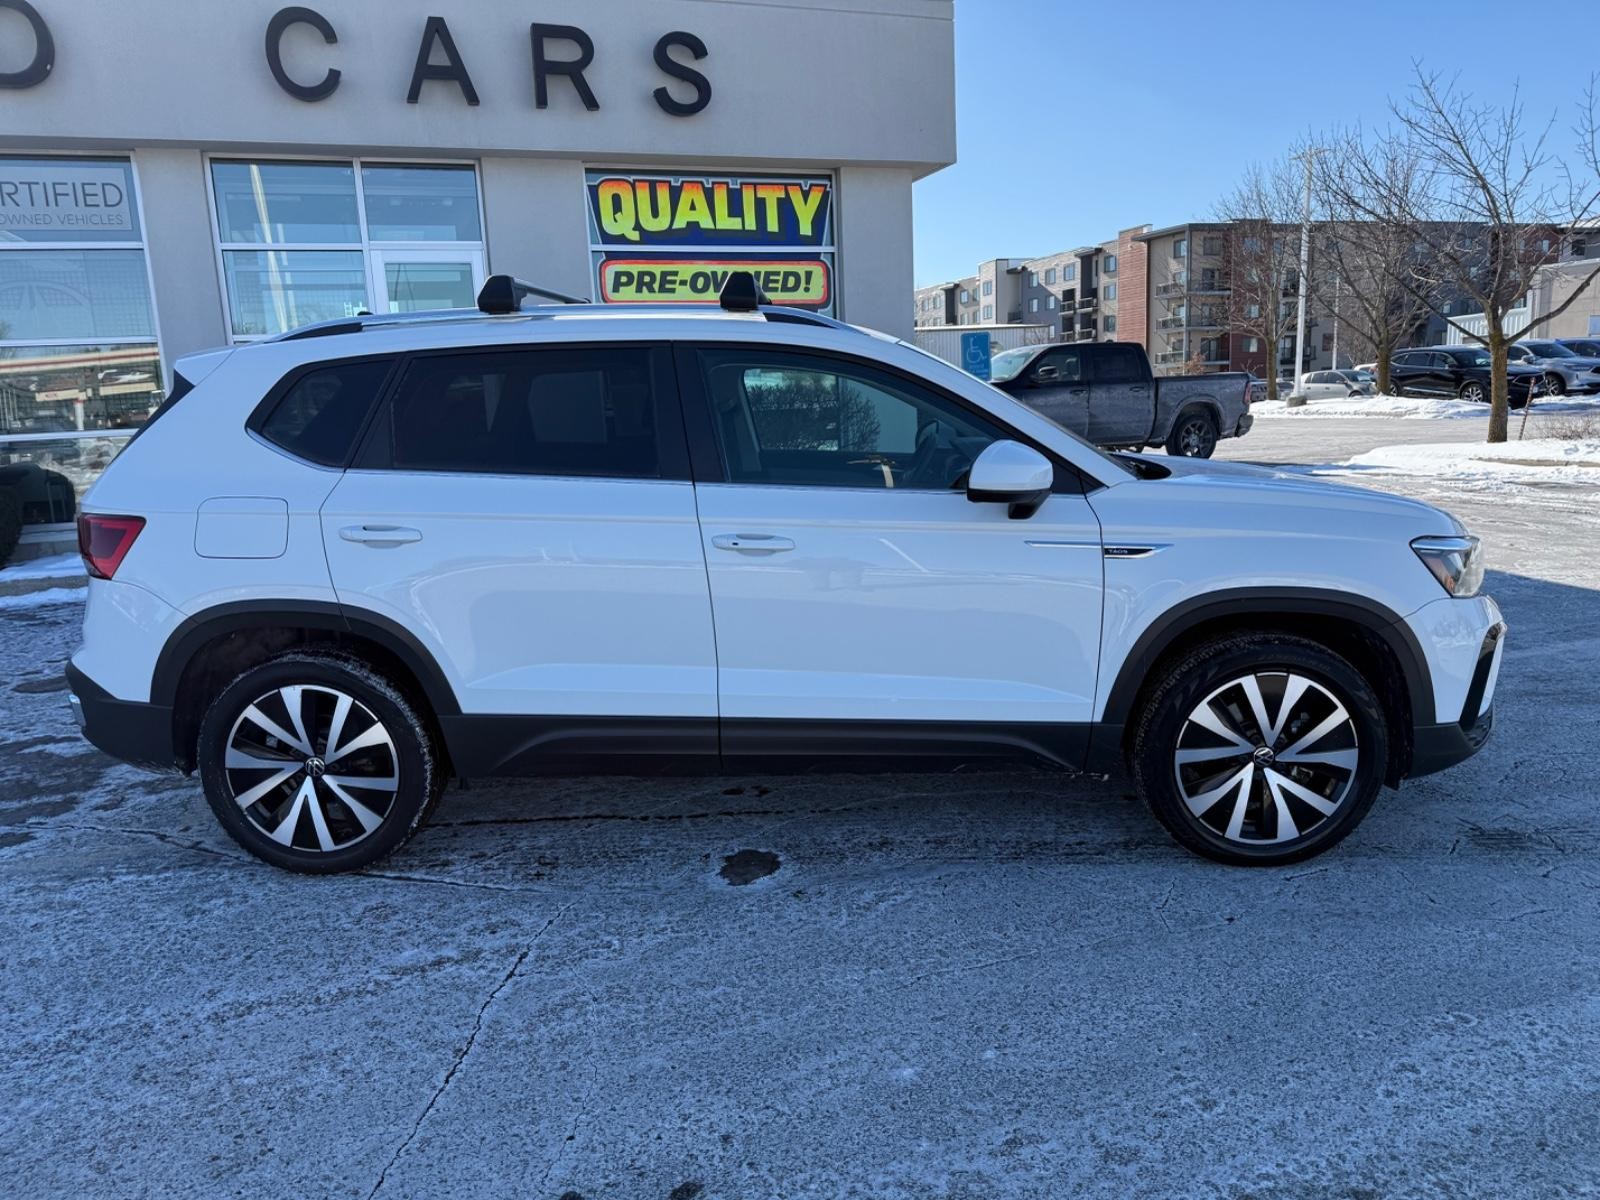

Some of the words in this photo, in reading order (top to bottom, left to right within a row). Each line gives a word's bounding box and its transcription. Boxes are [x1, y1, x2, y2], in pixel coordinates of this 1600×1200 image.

[265, 6, 712, 116] CARS
[56, 214, 124, 225] VEHICLES
[597, 179, 827, 241] QUALITY
[612, 270, 813, 293] PRE-OED!
